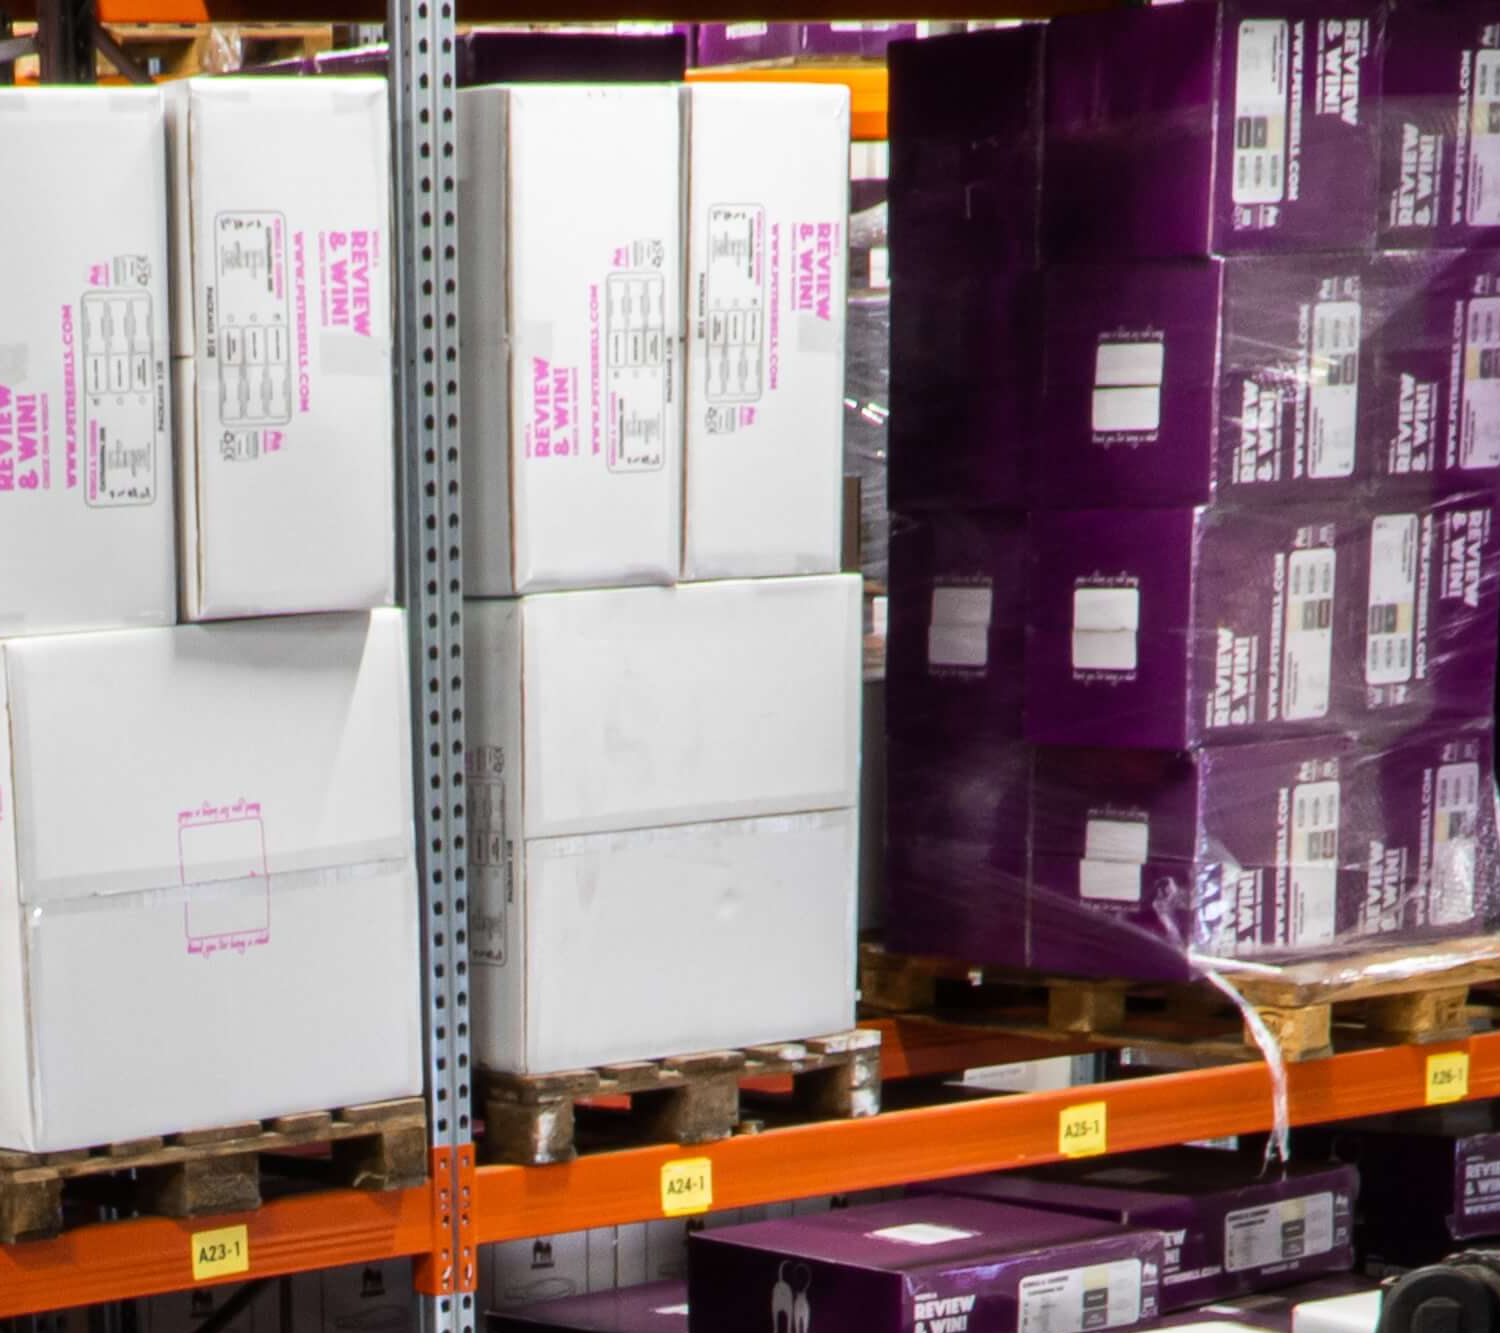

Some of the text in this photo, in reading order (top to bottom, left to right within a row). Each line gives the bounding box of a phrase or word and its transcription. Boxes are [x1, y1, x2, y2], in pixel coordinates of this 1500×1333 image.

[328, 232, 349, 324] & WIN!
[351, 230, 370, 336] REVIEW
[799, 224, 816, 308] & WIN!
[814, 223, 832, 320] REVIEW
[17, 395, 39, 490] & WIN!
[534, 357, 553, 458] REVIEW
[553, 368, 569, 455] & WIN!
[1432, 1068, 1463, 1084] A26-1
[1064, 1120, 1099, 1138] A25-1
[667, 1176, 704, 1194] A24-1
[199, 1240, 240, 1264] A23-1
[914, 1295, 975, 1324] REVIEW
